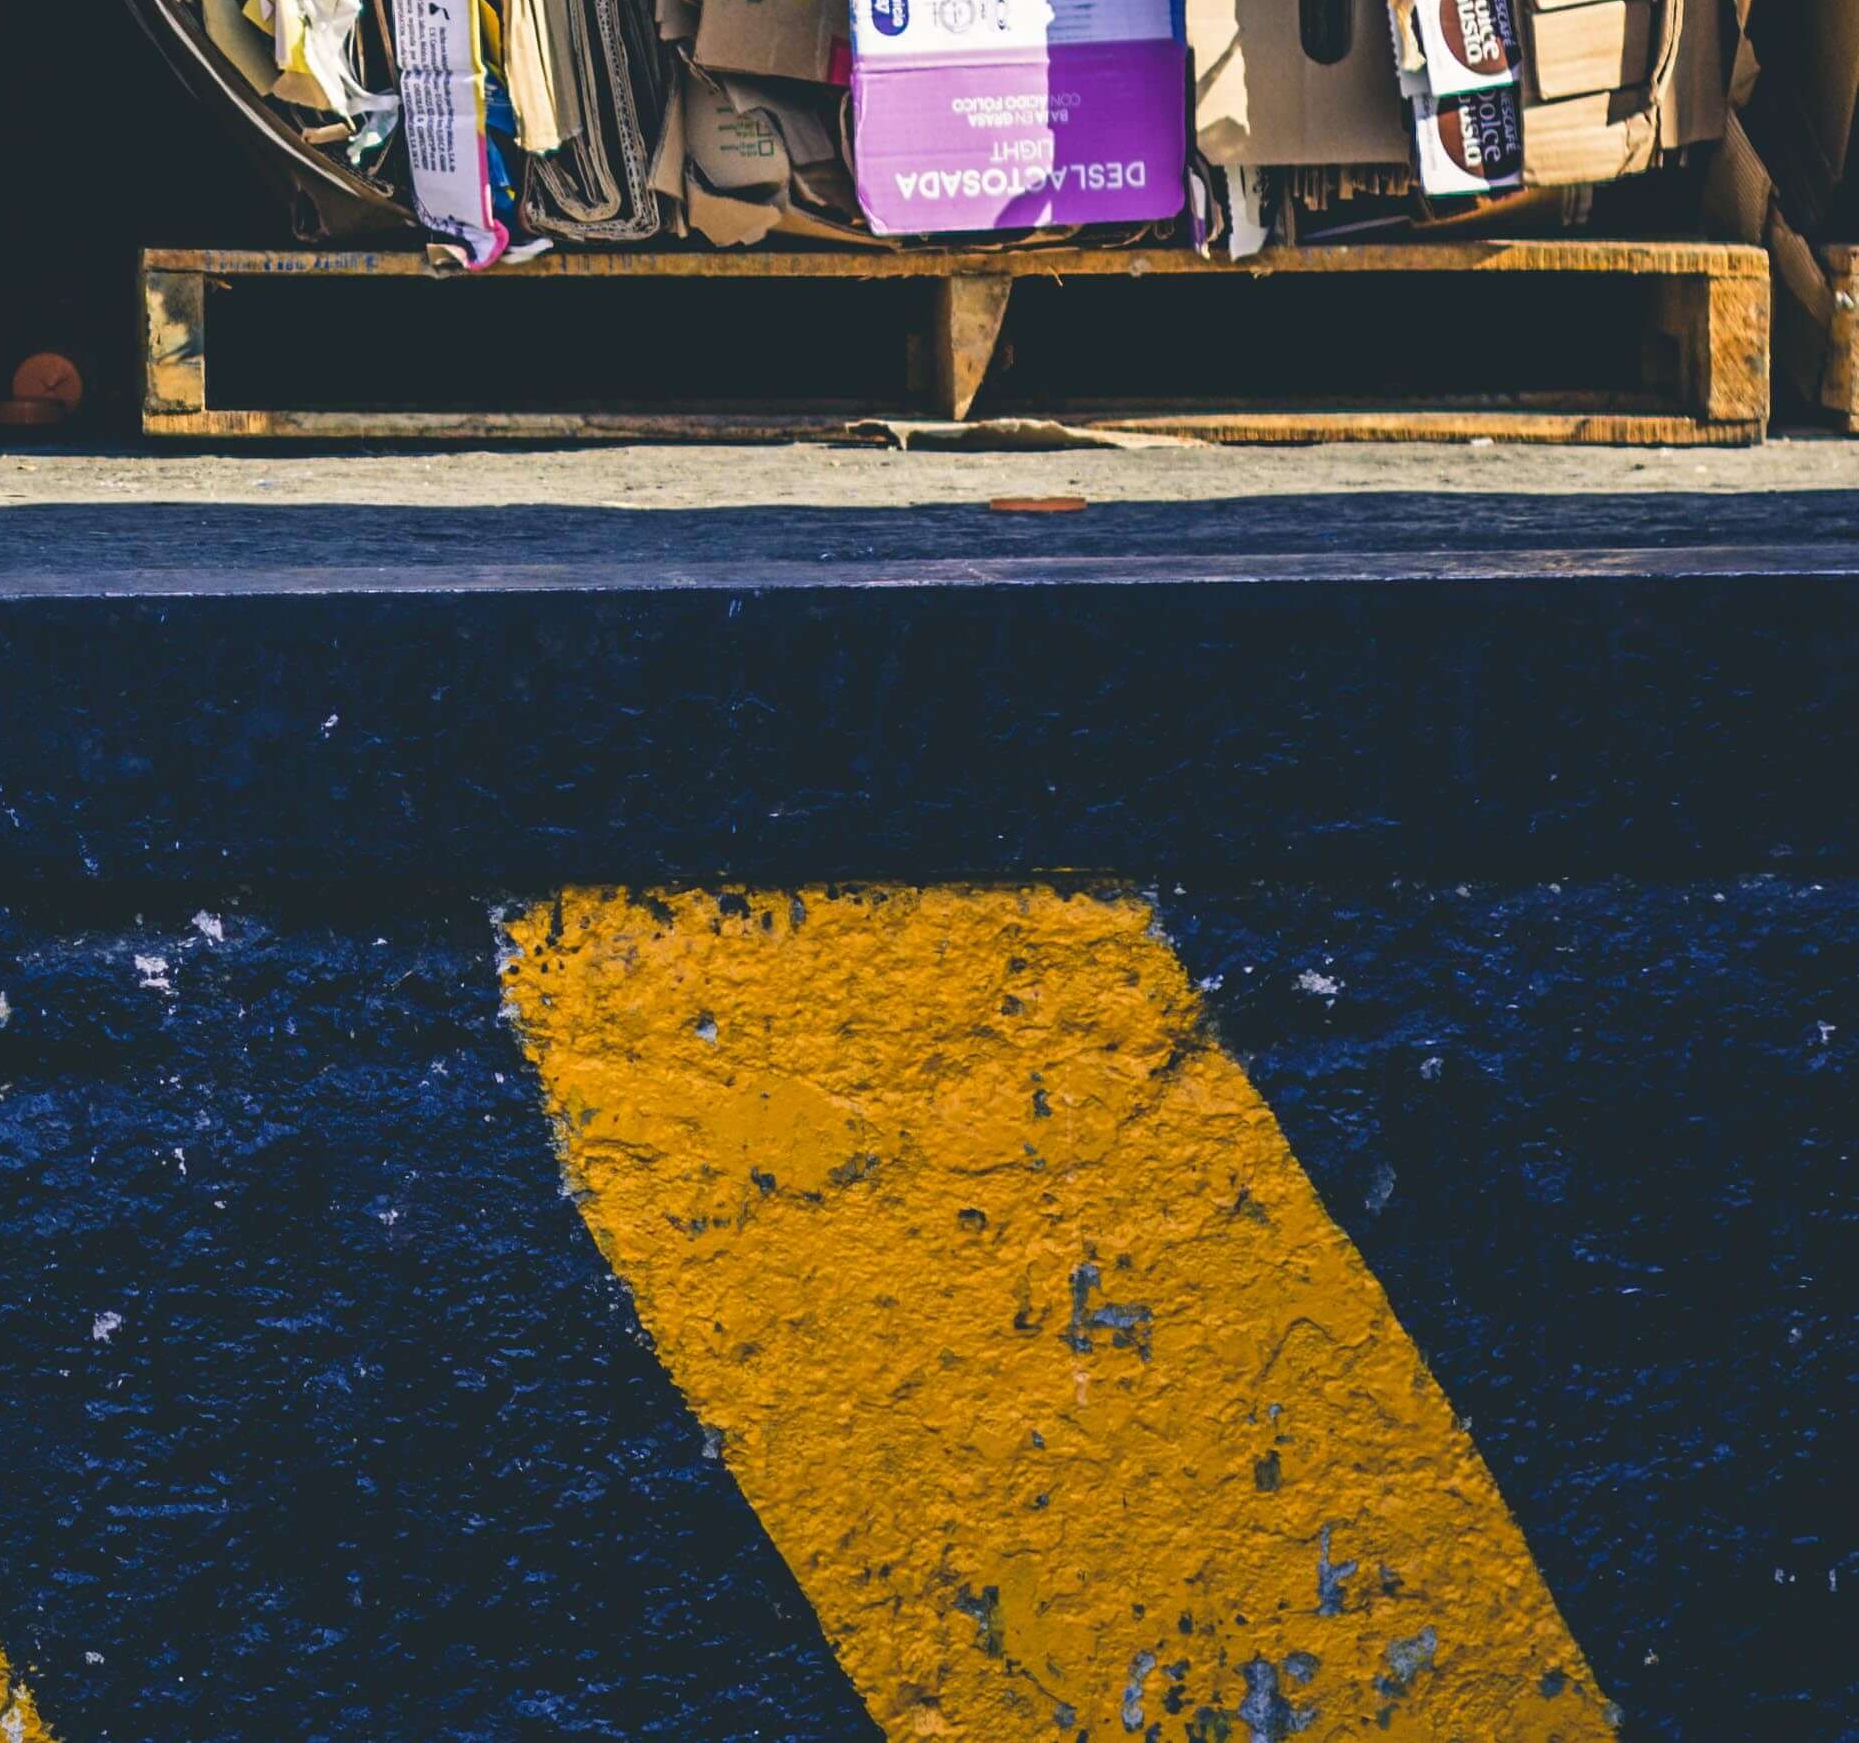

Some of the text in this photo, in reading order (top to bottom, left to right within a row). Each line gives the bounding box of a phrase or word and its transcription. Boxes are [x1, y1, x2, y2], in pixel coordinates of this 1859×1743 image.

[1049, 92, 1081, 107] CON
[967, 108, 1069, 128] BAJA EN GRASA
[1459, 95, 1483, 168] usto
[989, 139, 1055, 163] LIGHT
[894, 160, 1146, 201] DESLACTOSADA
